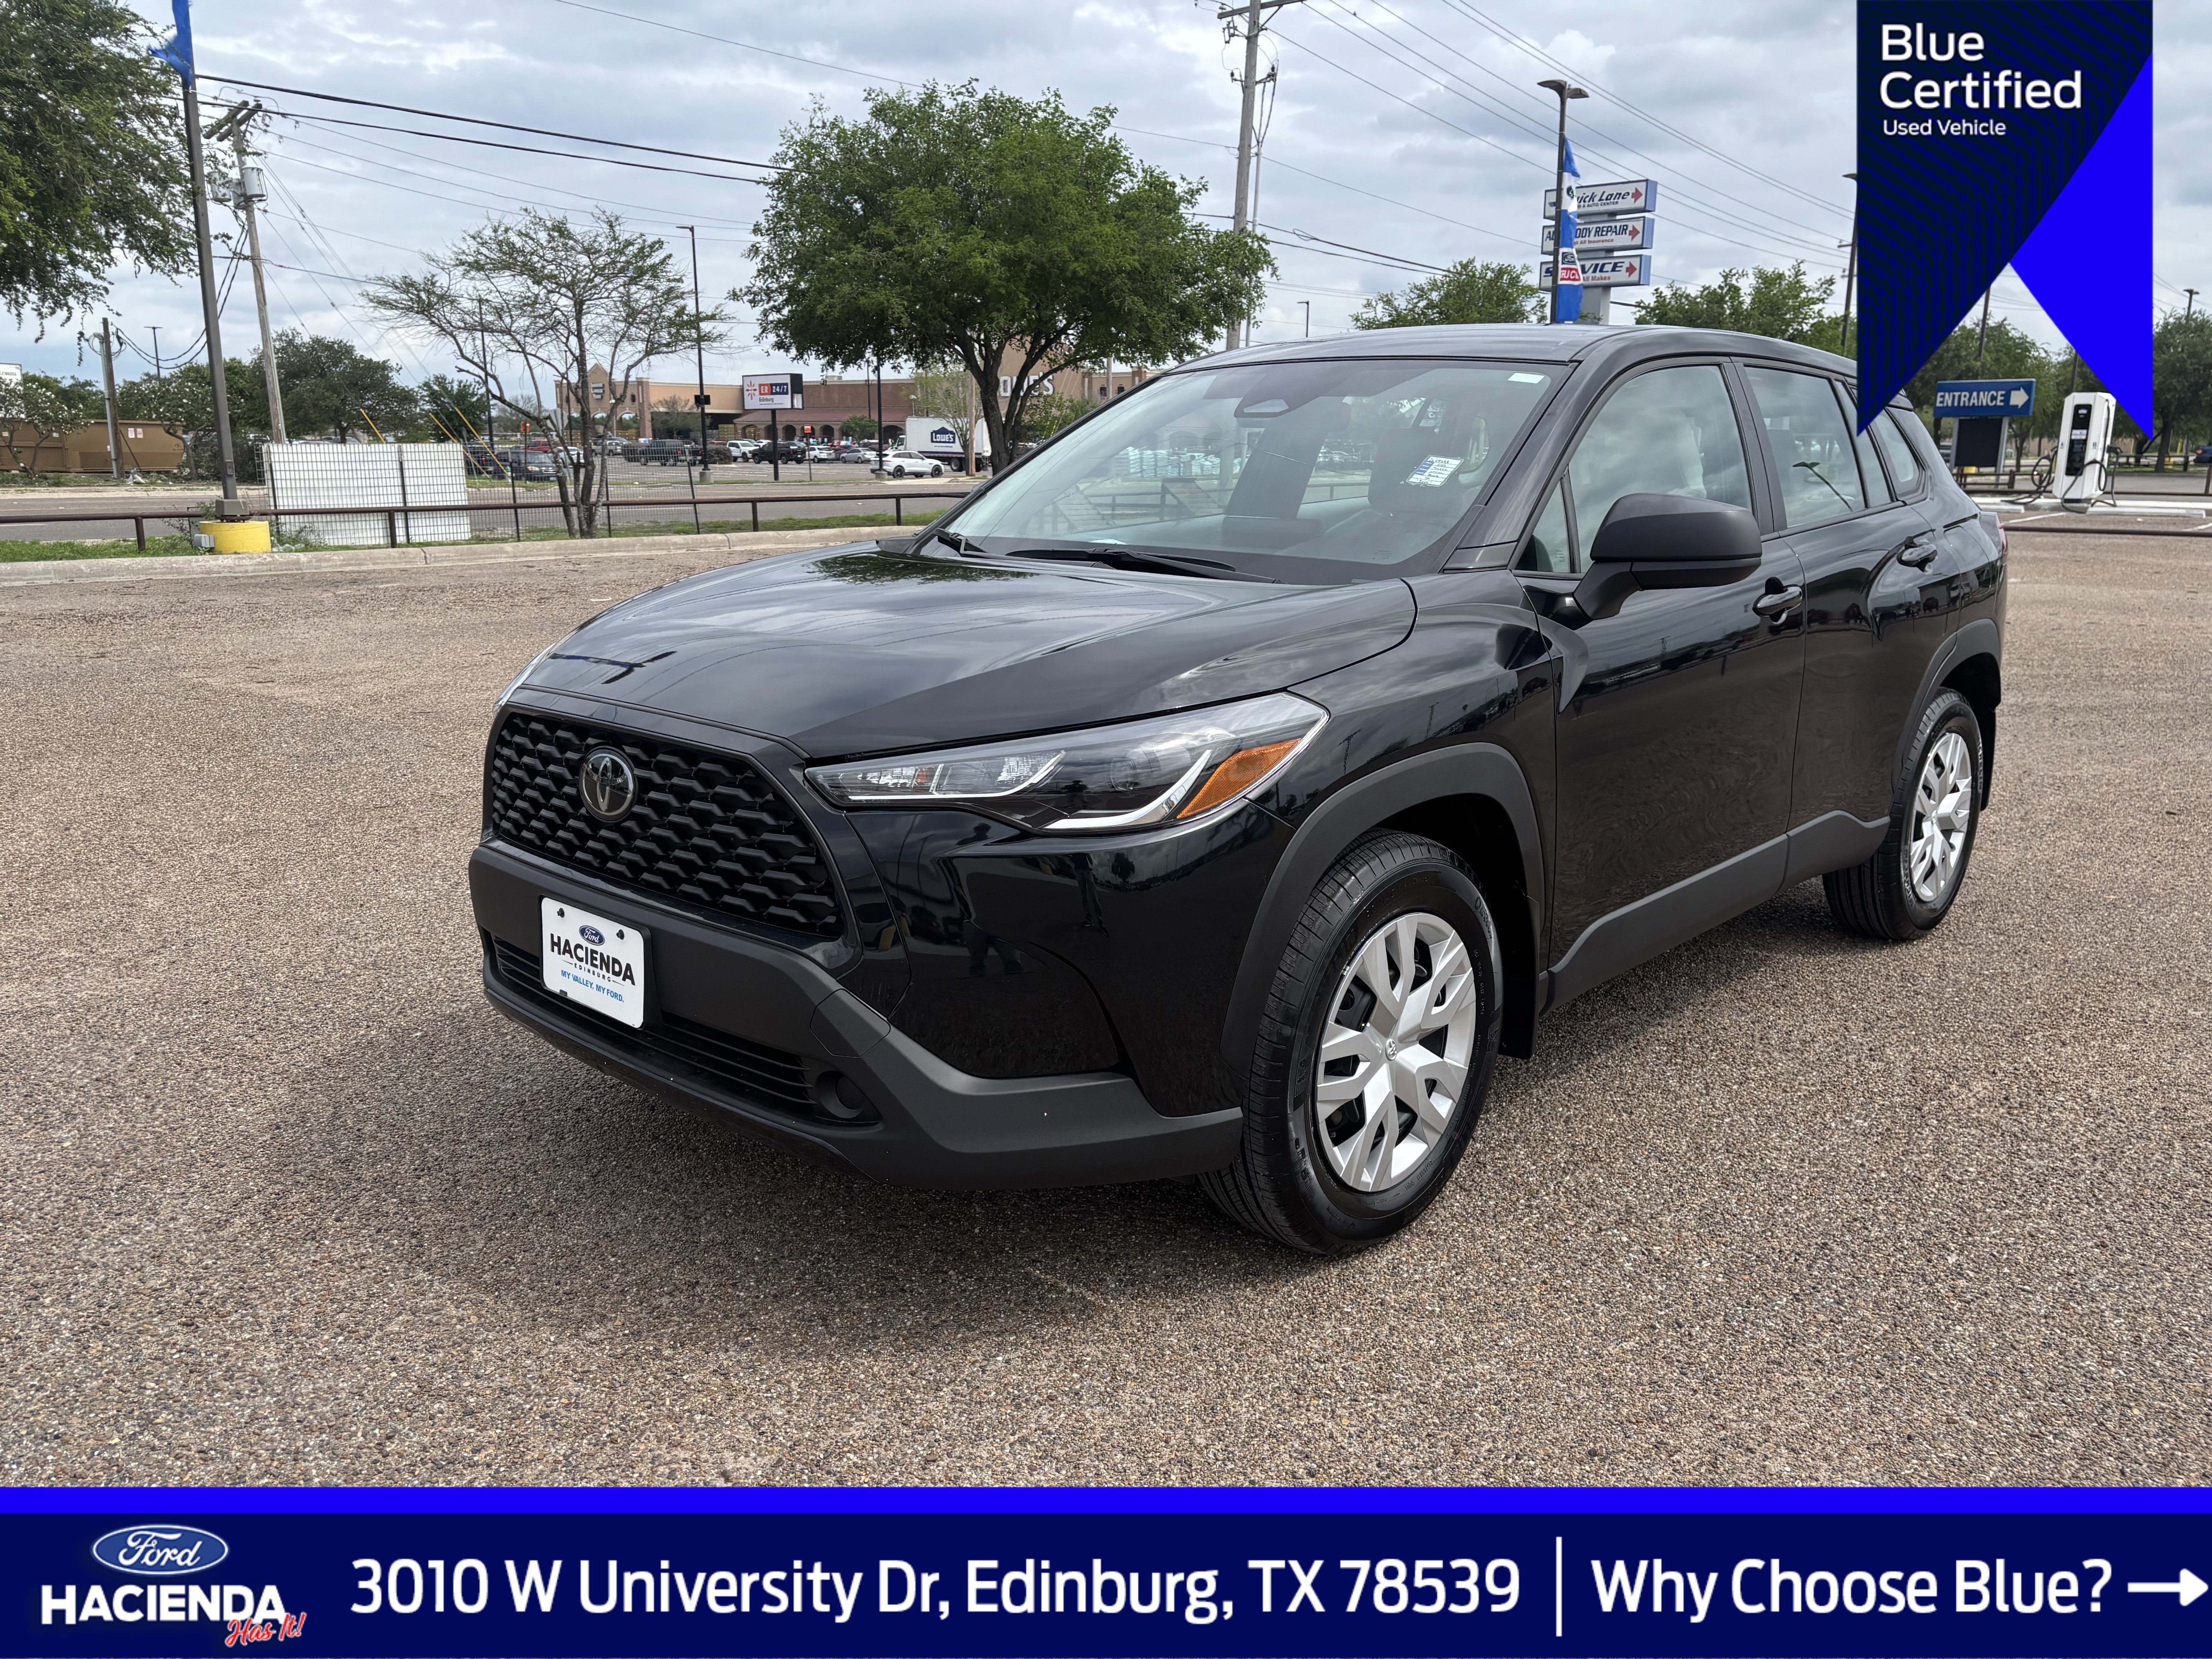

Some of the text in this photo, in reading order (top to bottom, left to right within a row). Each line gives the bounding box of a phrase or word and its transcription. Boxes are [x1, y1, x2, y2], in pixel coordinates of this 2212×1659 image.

[1599, 191, 1630, 203] Lane
[1575, 227, 1594, 239] ODY
[1594, 225, 1628, 237] REPAIR
[1561, 270, 1579, 279] RUC
[1936, 390, 2006, 407] ENTRANCE
[584, 927, 599, 943] Ford
[550, 933, 635, 986] HACIENDA
[574, 962, 611, 982] EDINBURG
[561, 969, 624, 1003] MY VALLEY. MY FORD.
